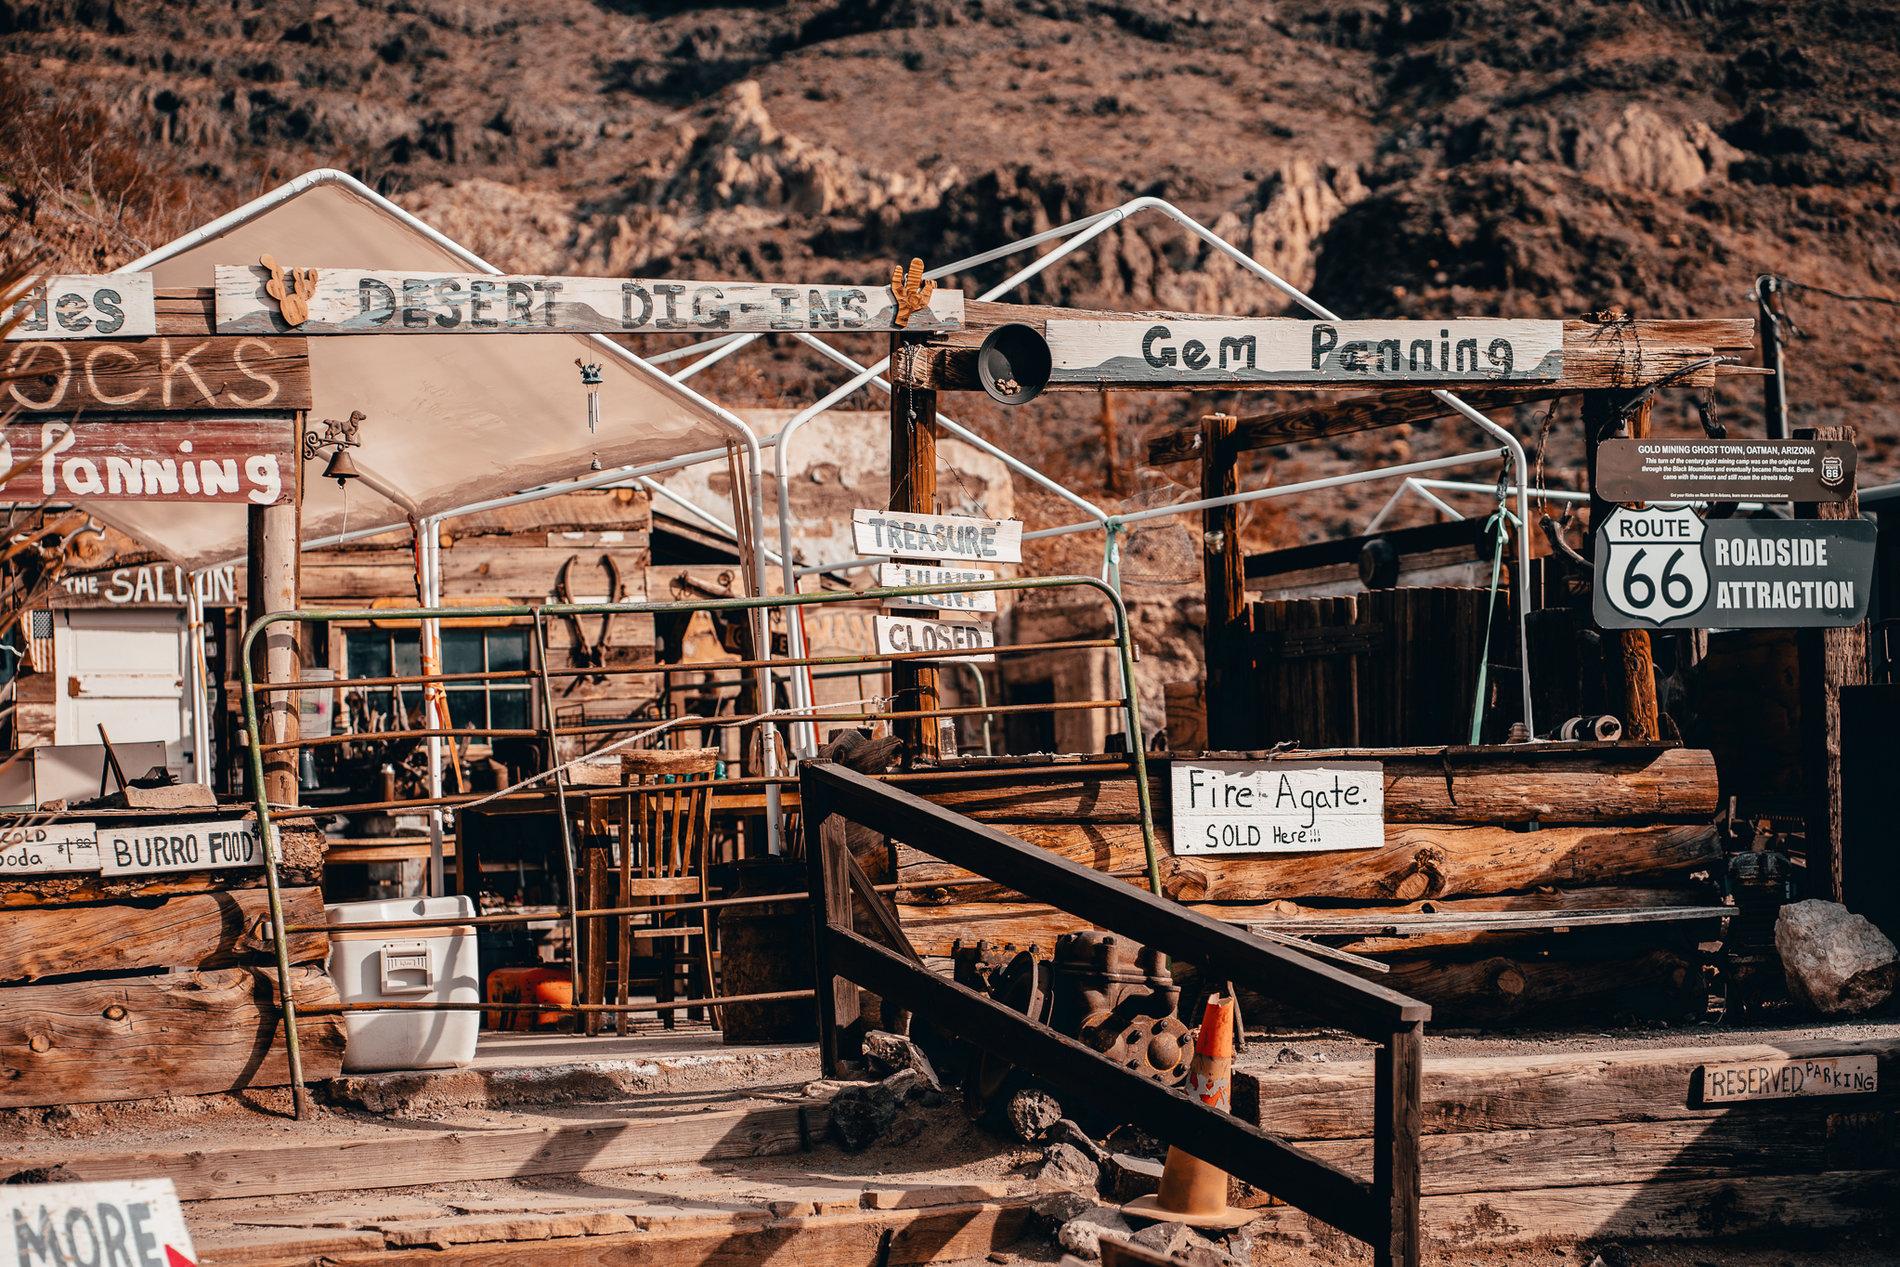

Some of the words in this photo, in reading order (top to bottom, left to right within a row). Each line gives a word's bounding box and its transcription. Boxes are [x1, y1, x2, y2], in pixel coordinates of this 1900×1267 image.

[358, 277, 564, 328] DESERT
[621, 282, 868, 330] DIG-INS
[1142, 325, 1256, 370] Gem
[1311, 323, 1514, 379] Panning
[1637, 445, 1661, 454] GOLD
[1661, 445, 1691, 454] MINING
[1691, 445, 1719, 454] GHOST
[1719, 446, 1746, 456] TOWN,
[1746, 446, 1780, 456] OATMAN,
[1781, 446, 1815, 455] ARIZONA
[869, 518, 998, 557] TREASURE
[1619, 519, 1691, 538] ROUTE
[1715, 538, 1828, 566] ROADSIDE
[61, 576, 99, 595] THE
[1623, 547, 1693, 609] 66
[1716, 581, 1855, 609] ATTRACTION
[888, 623, 983, 653] CLOSED
[1190, 769, 1252, 809] Fire
[1275, 773, 1367, 828] Agate.
[113, 833, 199, 867] BURRO
[208, 831, 254, 863] FOOD
[1205, 824, 1262, 848] SOLD
[0, 848, 43, 867] oda
[1712, 1066, 1804, 1096] RESERVED
[1806, 1060, 1875, 1091] PARKING
[13, 1203, 164, 1267] MORE
